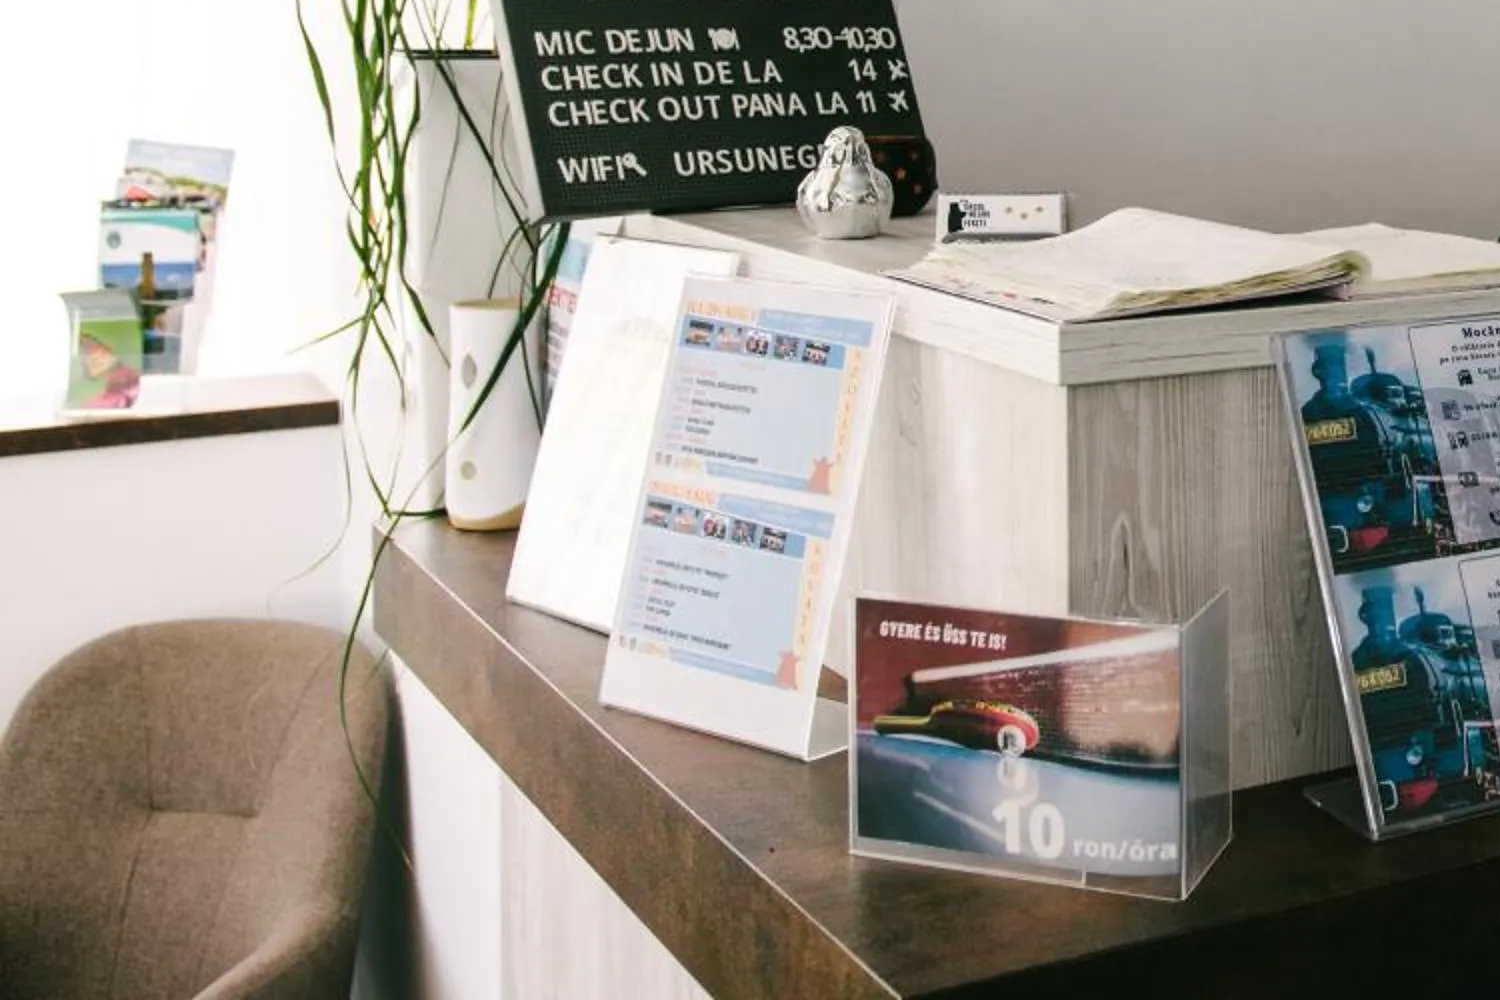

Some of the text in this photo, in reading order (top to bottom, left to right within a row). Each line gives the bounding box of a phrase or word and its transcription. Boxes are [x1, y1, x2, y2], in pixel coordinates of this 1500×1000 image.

[533, 29, 596, 57] MIC
[604, 27, 695, 54] DEJUN
[541, 58, 878, 91] CHECK IN DE LA 14
[548, 90, 877, 127] CHECK OUT PANA LA 11
[557, 154, 625, 184] WIFI
[879, 620, 923, 640] GYERE
[924, 621, 941, 642] ÉS
[970, 630, 987, 648] TE
[988, 632, 1007, 651] IS!
[992, 800, 1178, 862] 10 ron/óra
